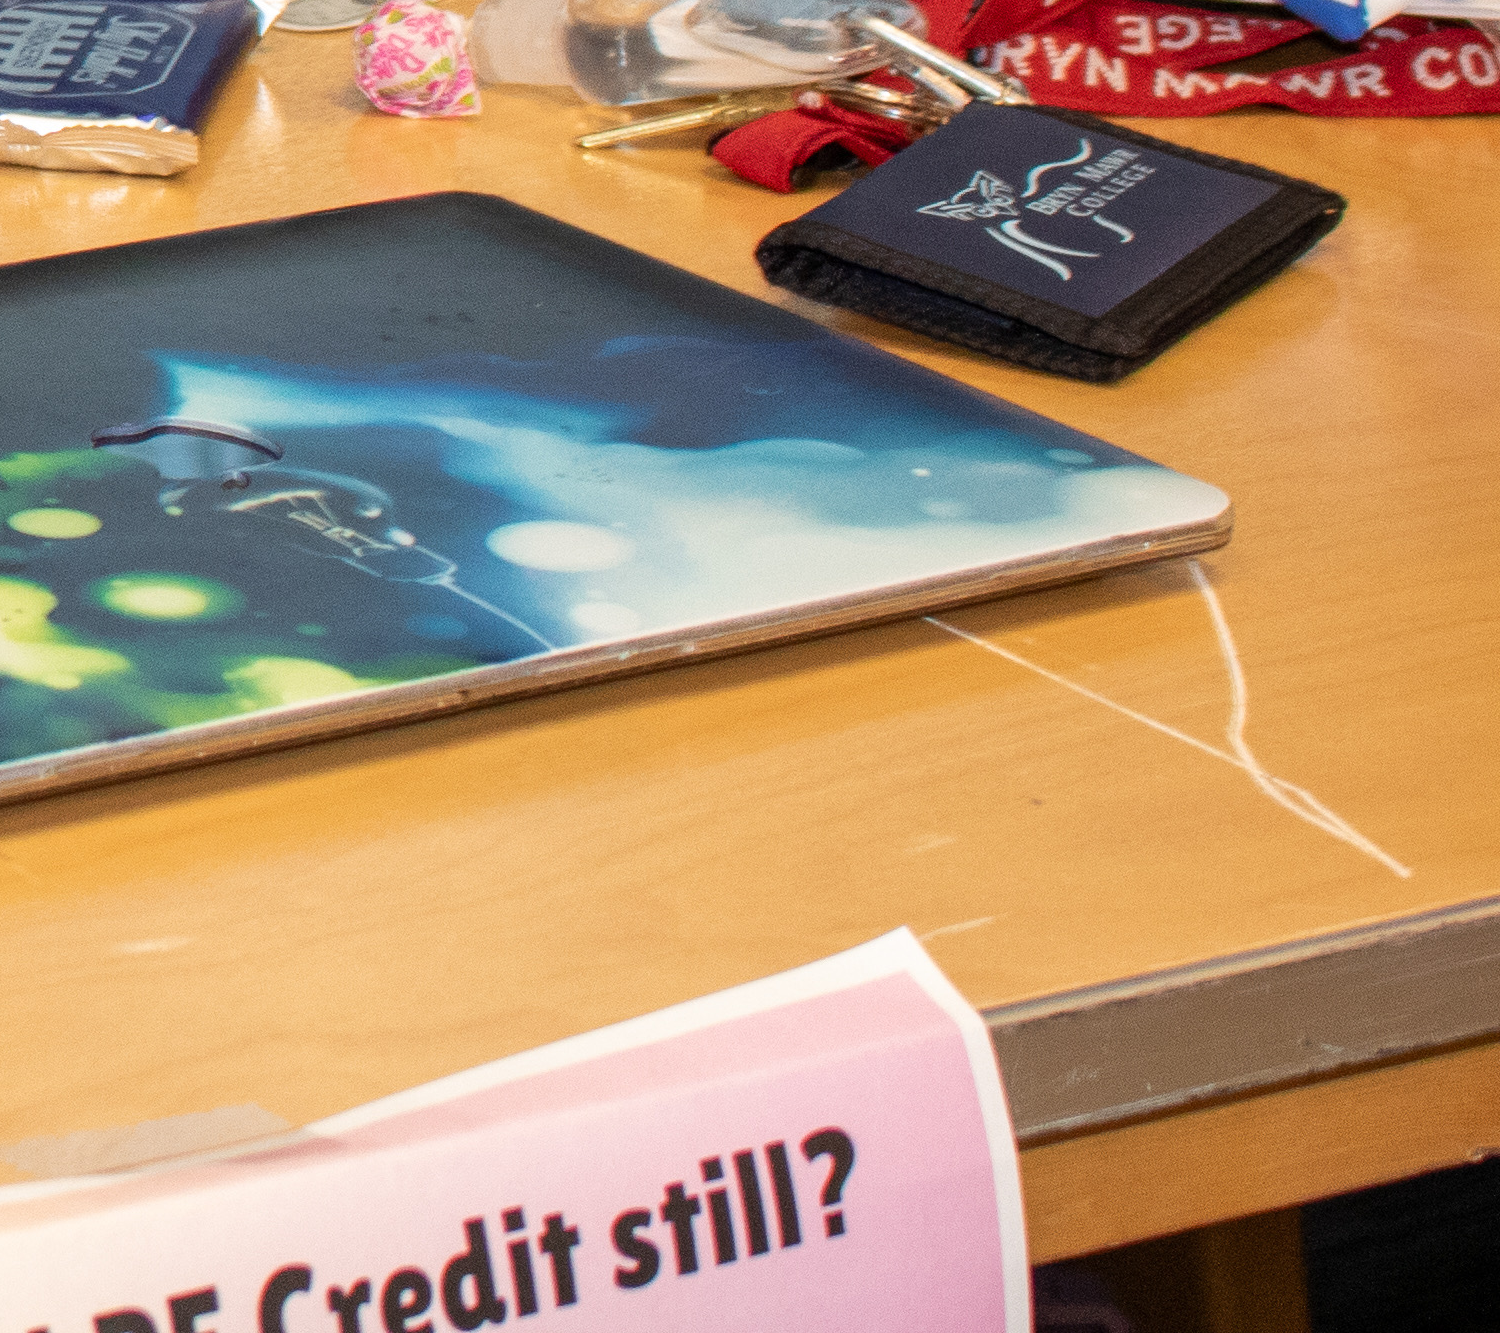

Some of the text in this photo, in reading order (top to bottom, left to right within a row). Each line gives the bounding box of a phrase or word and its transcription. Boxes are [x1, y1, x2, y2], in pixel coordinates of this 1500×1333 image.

[1025, 148, 1142, 216] BRYN MAWR
[1065, 163, 1156, 217] COLLEGE
[608, 1125, 858, 1292] still?
